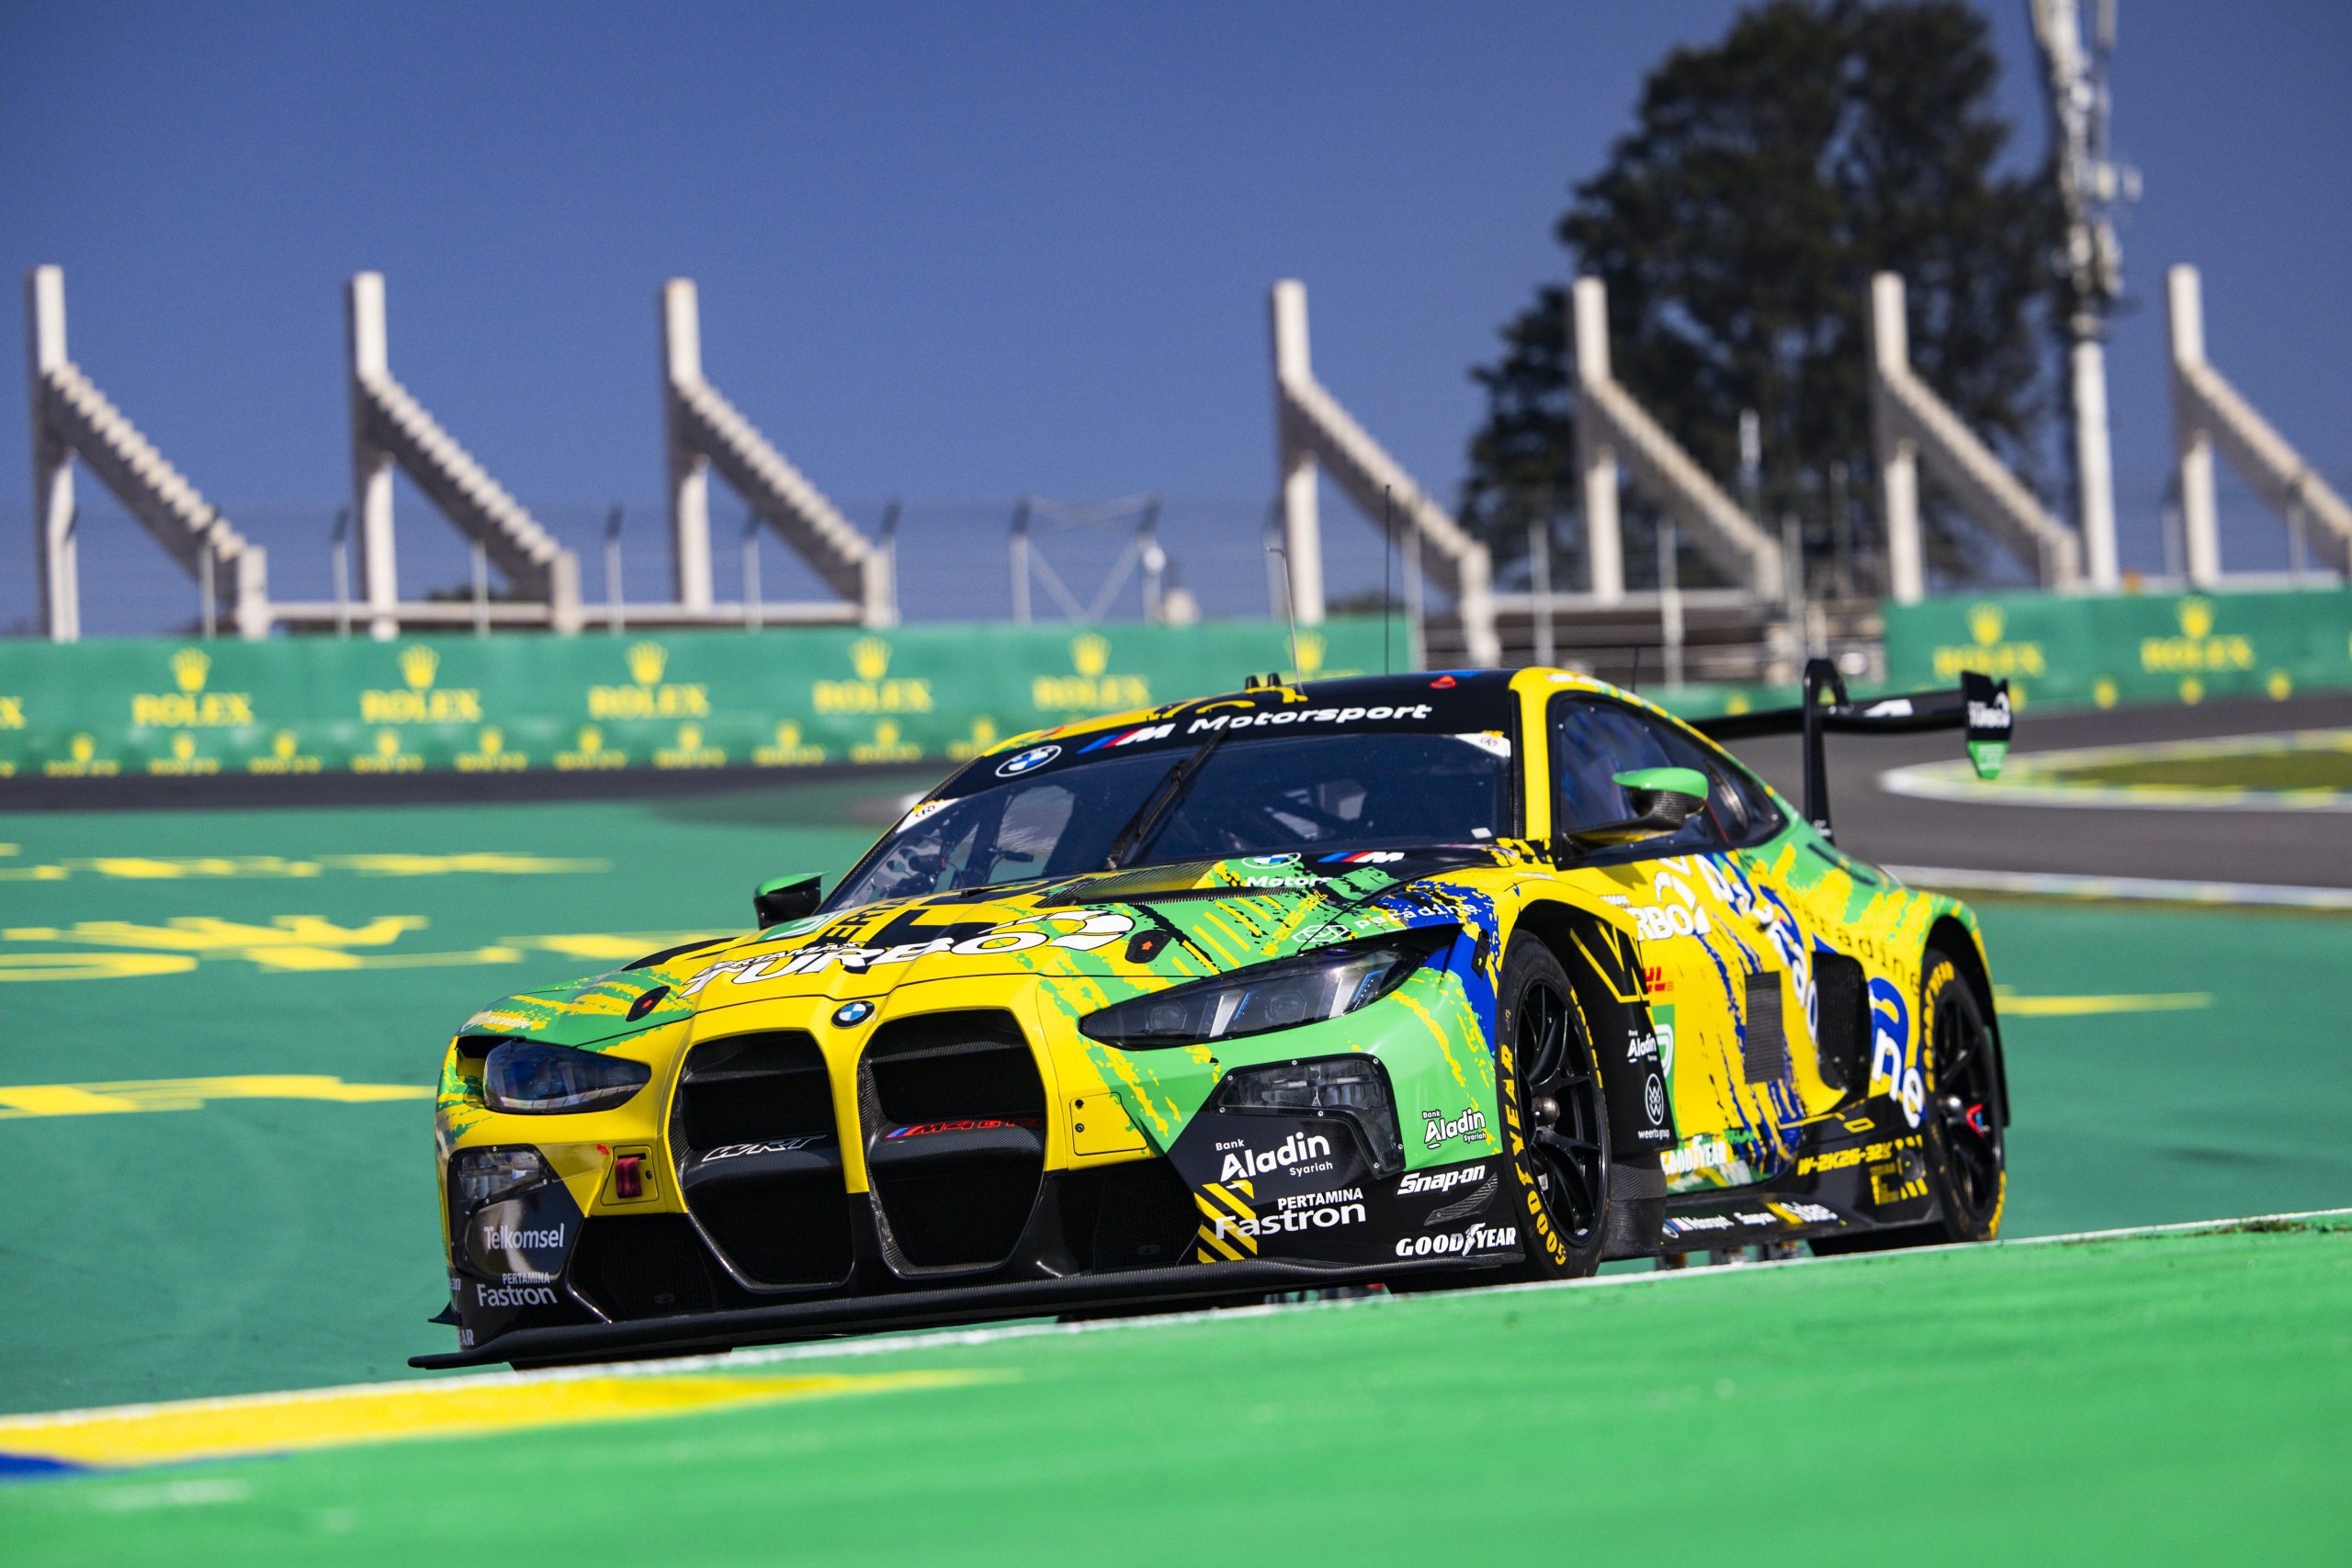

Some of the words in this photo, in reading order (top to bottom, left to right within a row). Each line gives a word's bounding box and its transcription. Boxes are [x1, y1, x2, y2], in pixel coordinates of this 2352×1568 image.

[1186, 704, 1432, 734] Motorsport
[1354, 902, 1477, 931] paradine
[1423, 1110, 1441, 1119] Bank
[1424, 1108, 1486, 1145] Aladin
[1216, 1138, 1245, 1151] Bank
[1464, 1132, 1487, 1143] Syariah
[1638, 1128, 1659, 1139] weerts
[1220, 1132, 1330, 1182] Aladin
[1501, 1043, 1566, 1266] GOODYEAR
[1290, 1161, 1333, 1177] Syariah
[1397, 1164, 1485, 1195] Snap-on
[1278, 1188, 1363, 1211] PERTAMINA
[1216, 1202, 1366, 1240] Fastron
[483, 1223, 564, 1250] Telkomsel
[1396, 1223, 1517, 1257] GOODYEAR
[503, 1272, 550, 1284] PERTAMINA
[476, 1283, 558, 1306] Fastron
